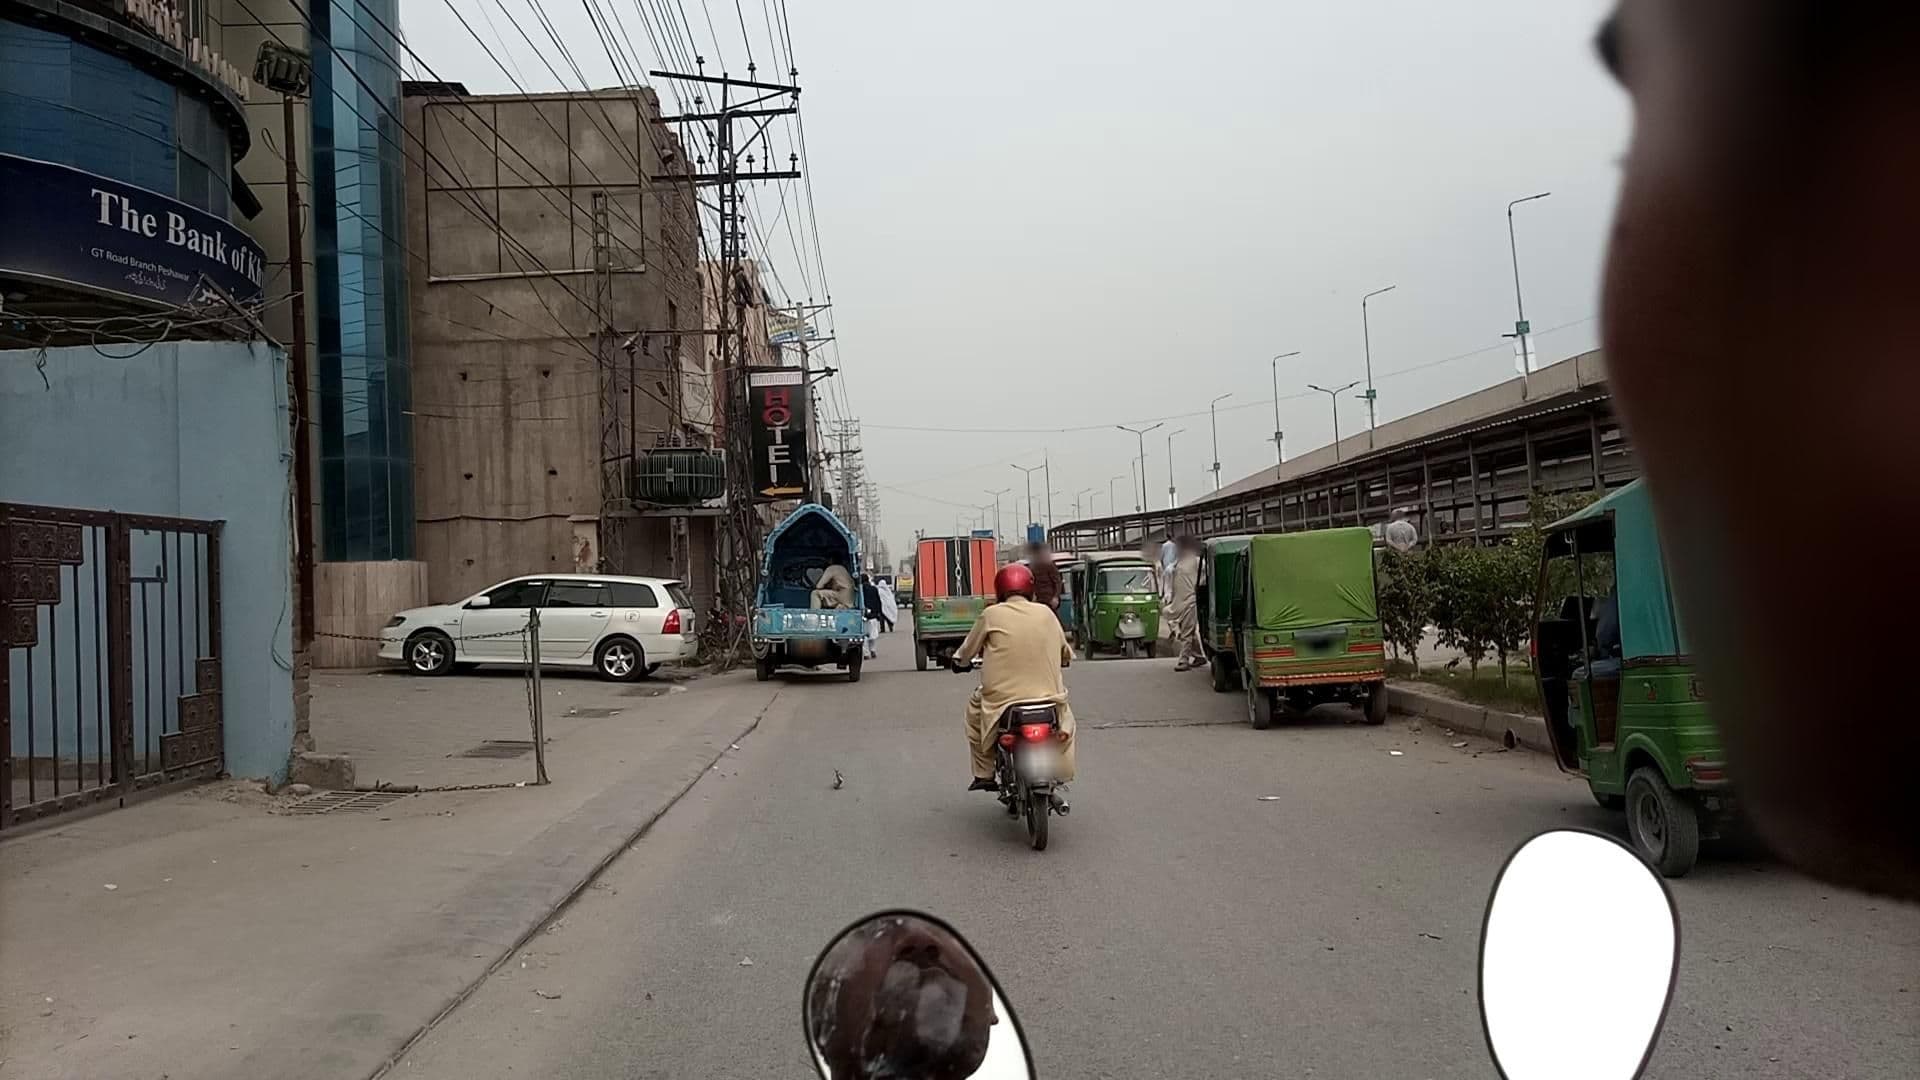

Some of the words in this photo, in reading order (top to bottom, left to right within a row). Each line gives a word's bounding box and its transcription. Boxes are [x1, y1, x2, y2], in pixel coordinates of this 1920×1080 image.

[91, 188, 158, 238] The
[167, 211, 228, 265] Bank
[231, 245, 247, 274] of
[91, 247, 104, 258] GT
[106, 251, 129, 265] Road
[130, 256, 157, 272] Branch
